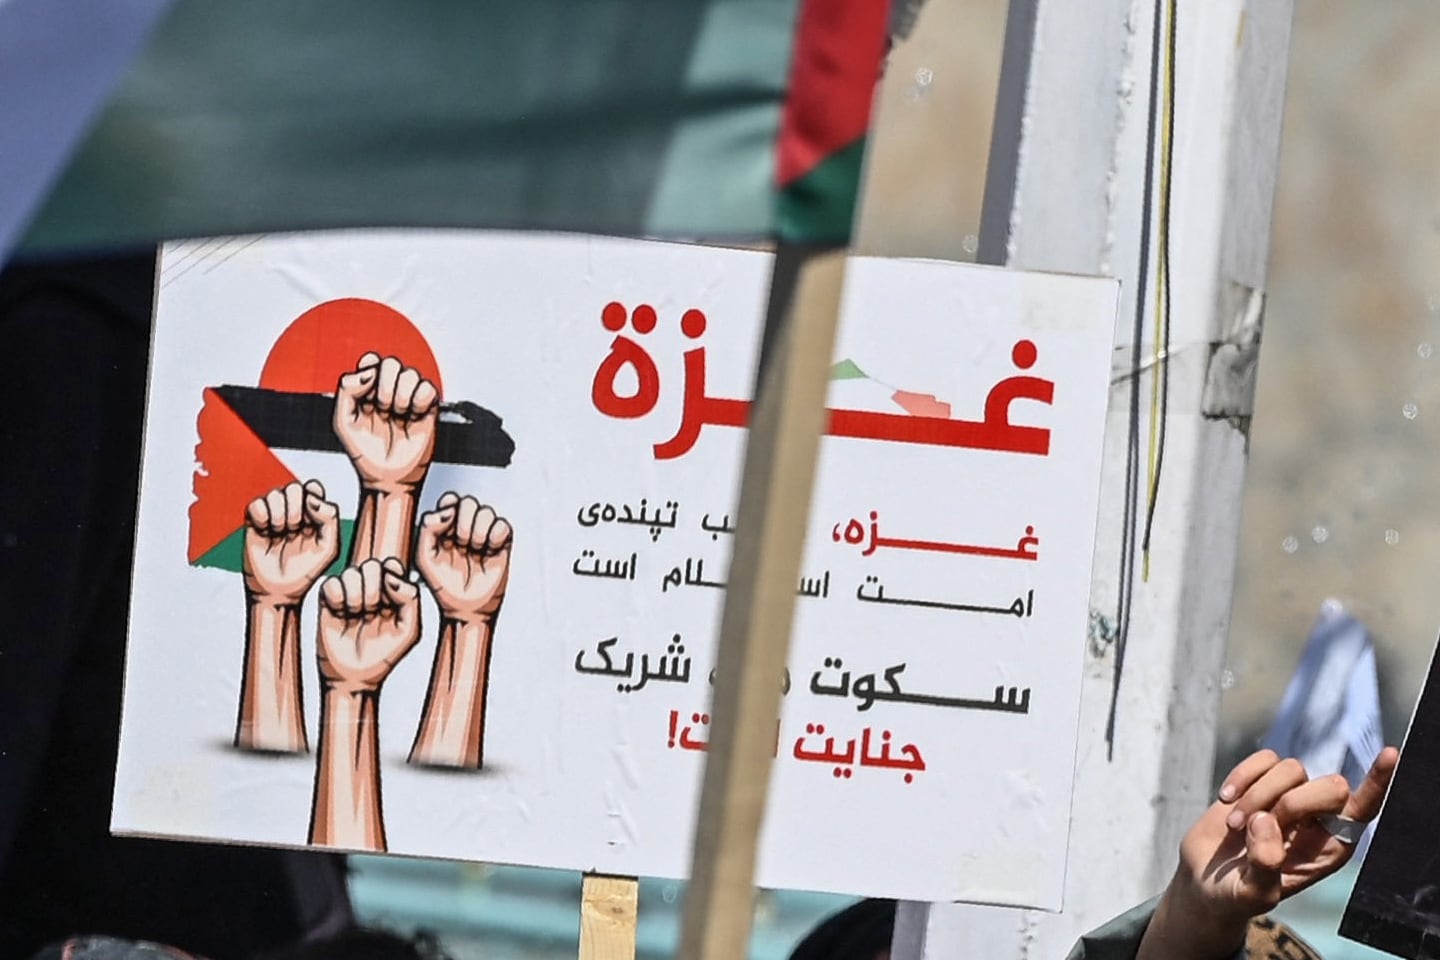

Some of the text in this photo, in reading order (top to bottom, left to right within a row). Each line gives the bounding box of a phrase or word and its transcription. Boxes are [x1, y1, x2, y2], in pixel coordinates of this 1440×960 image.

[573, 550, 637, 580] است
[857, 575, 1034, 618] امت
[794, 723, 927, 784] جنایت
